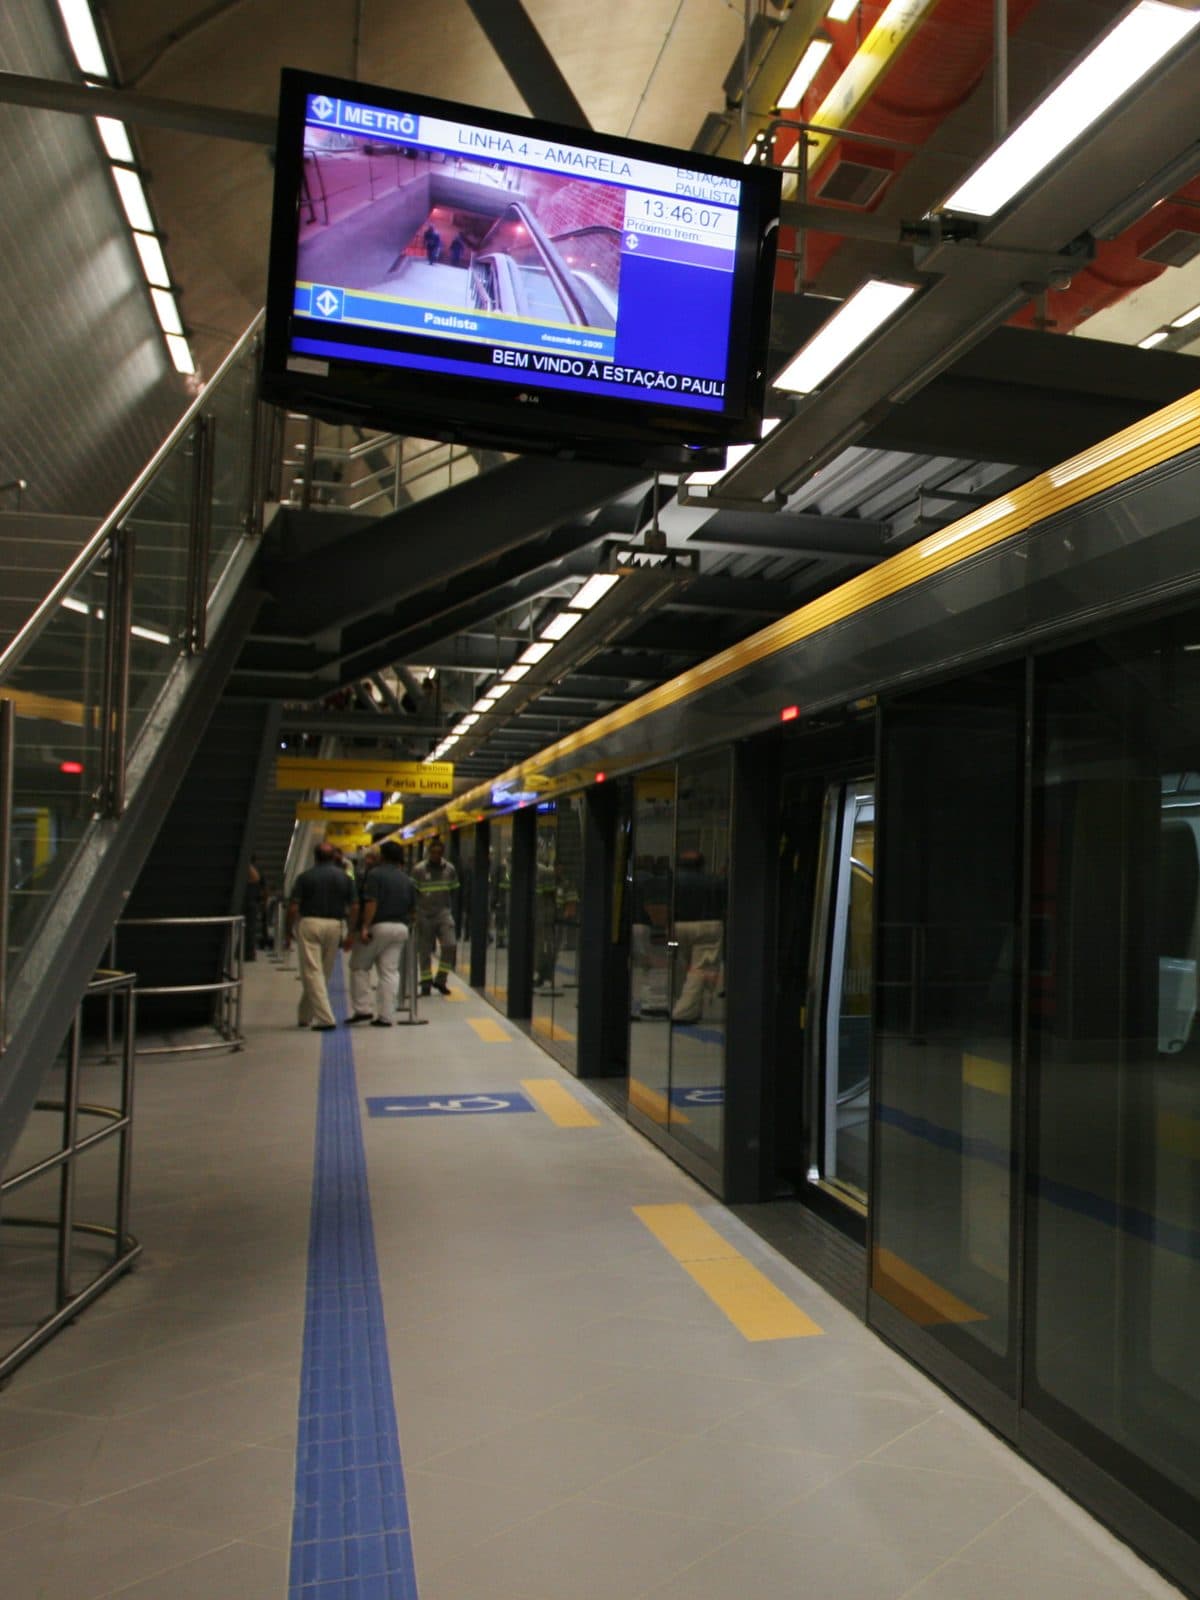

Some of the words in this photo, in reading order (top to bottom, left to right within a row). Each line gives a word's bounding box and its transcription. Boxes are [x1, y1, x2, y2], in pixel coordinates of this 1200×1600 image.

[344, 106, 414, 134] METRÔ
[458, 129, 514, 153] LINHA
[518, 142, 528, 156] 4
[544, 147, 632, 177] AMARELA
[675, 182, 738, 204] PAULISTA
[643, 199, 722, 228] 13:46:07
[424, 312, 478, 331] Paulista
[492, 349, 528, 368] BEM
[532, 354, 583, 376] VINDO
[587, 361, 599, 378] À
[603, 366, 678, 389] ESTAÇÃO
[681, 377, 725, 397] PAULI
[385, 777, 415, 789] Faria
[419, 779, 448, 790] Lima
